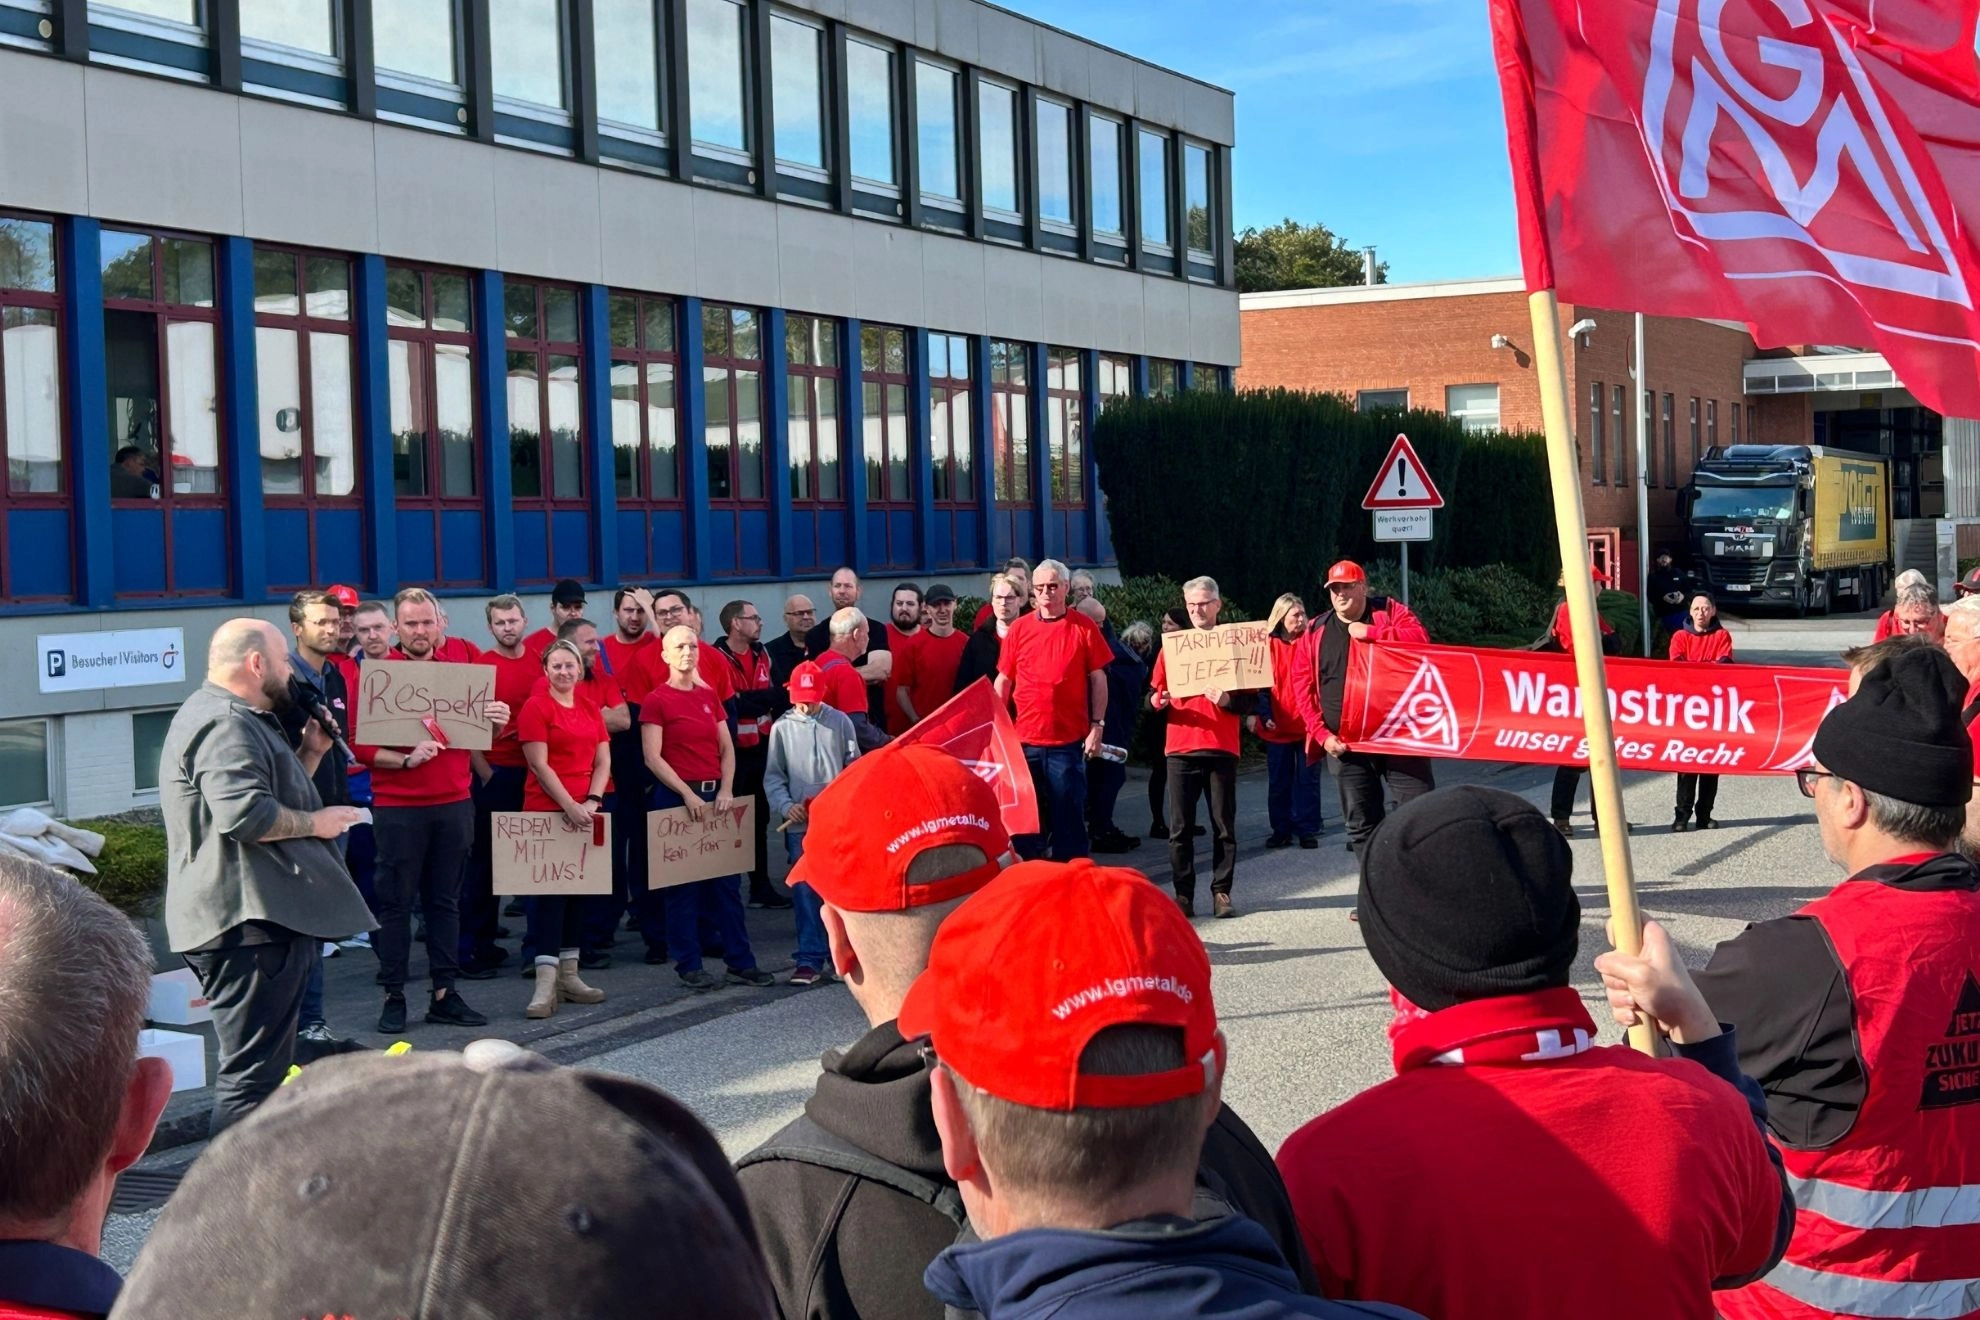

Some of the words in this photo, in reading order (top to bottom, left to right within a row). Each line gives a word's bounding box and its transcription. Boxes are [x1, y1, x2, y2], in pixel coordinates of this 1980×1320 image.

[71, 651, 118, 669] Besucher
[1494, 728, 1574, 752] unser
[1571, 736, 1656, 761] gtes
[1660, 739, 1746, 767] Recht
[497, 815, 552, 839] REDEN
[514, 838, 557, 864] MIT
[1955, 1013, 1980, 1034] JET
